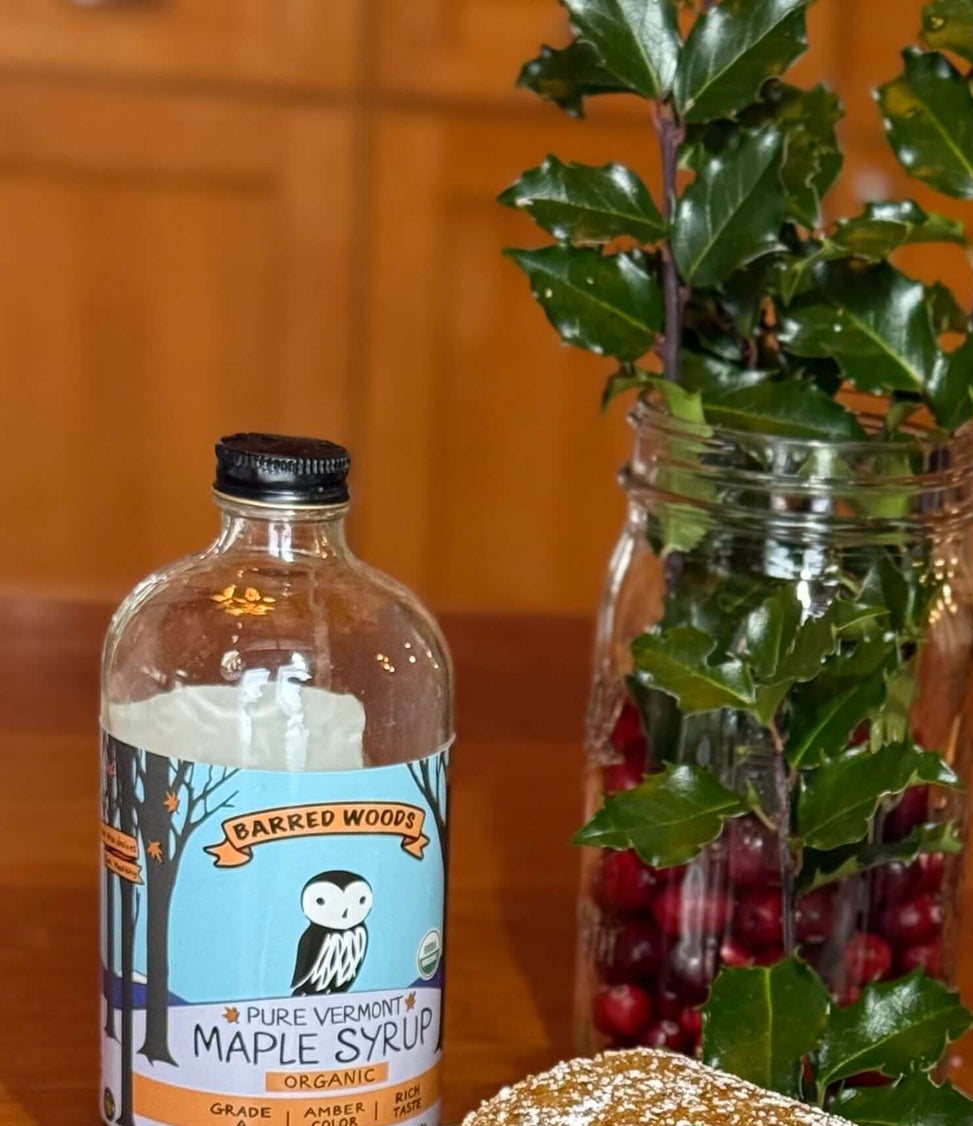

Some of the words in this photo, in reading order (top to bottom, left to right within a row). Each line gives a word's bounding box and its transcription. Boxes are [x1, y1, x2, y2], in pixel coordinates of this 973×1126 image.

[233, 809, 335, 841] BARRED
[343, 808, 416, 829] WOODS
[247, 1006, 307, 1026] PURE
[314, 995, 403, 1026] VERMONT
[194, 1023, 320, 1066] MAPLE
[335, 1007, 433, 1064] SYRUP
[284, 1068, 376, 1089] ORGANIC
[395, 1084, 421, 1104] RICH
[210, 1102, 272, 1118] GRADE
[304, 1102, 366, 1119] AMBER
[393, 1097, 422, 1119] TASTE
